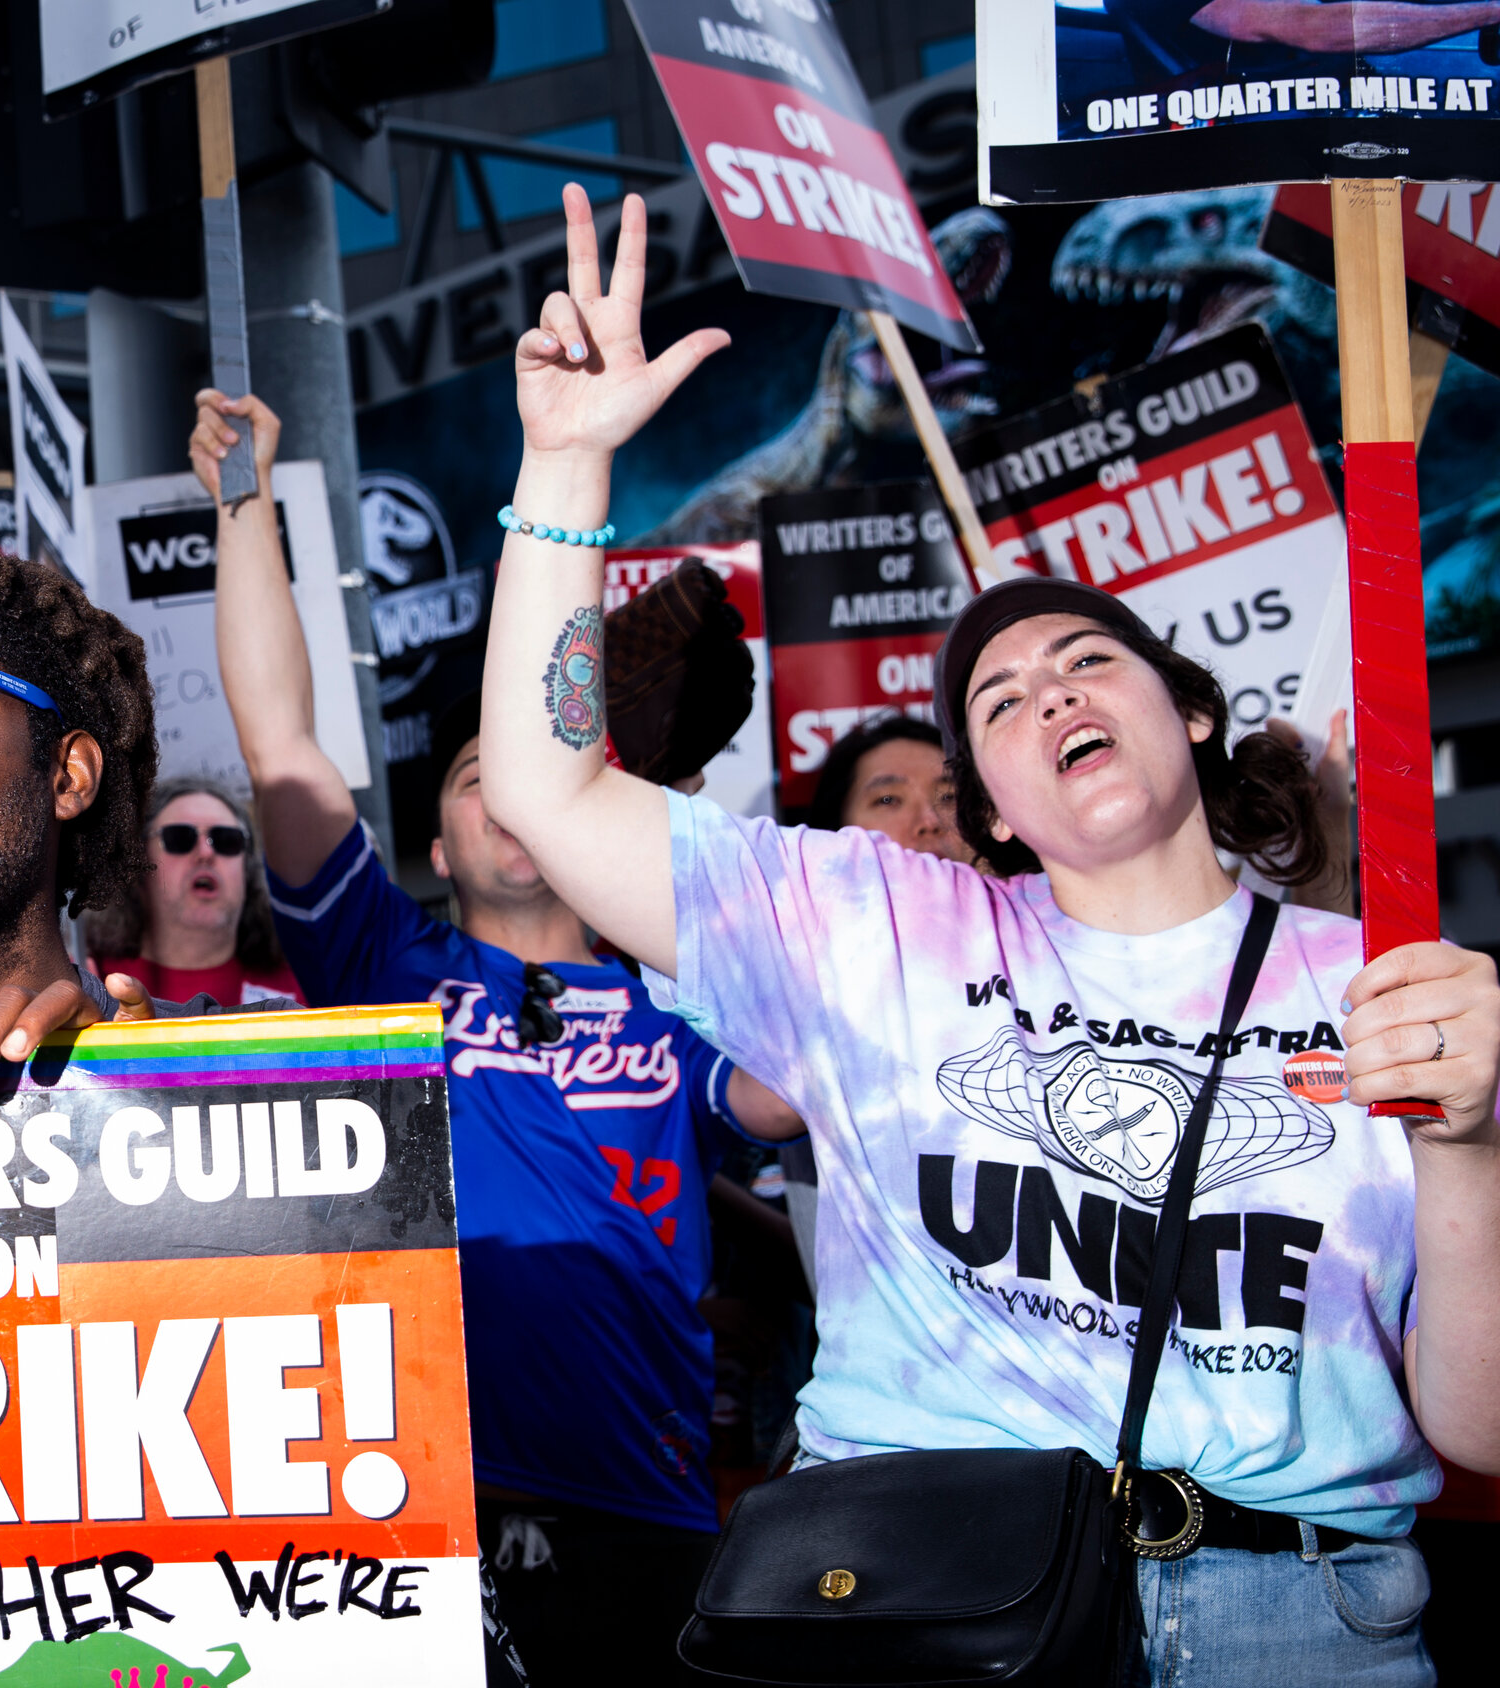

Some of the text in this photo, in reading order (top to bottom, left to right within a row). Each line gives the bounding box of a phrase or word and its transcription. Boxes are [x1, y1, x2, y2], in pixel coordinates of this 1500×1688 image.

[697, 17, 826, 94] AMERICA
[772, 102, 836, 159] ON
[1086, 76, 1493, 133] ONE QUARTER MILE AT
[704, 141, 934, 279] STRIKE!
[963, 359, 1260, 507] WRITERS GUILD
[1098, 455, 1141, 491] ON
[776, 511, 918, 557] WRITERS
[990, 430, 1305, 587] STRIKE!
[878, 553, 915, 583] OF
[371, 586, 482, 660] WORLD
[829, 584, 970, 630] AMERICA
[1202, 588, 1292, 647] US
[877, 653, 934, 695] ON
[1087, 1017, 1344, 1061] SAG-AFTRA
[1284, 1060, 1346, 1073] WRITERS GUIL
[1128, 1067, 1154, 1082] NO
[1283, 1072, 1305, 1088] ON
[98, 1098, 388, 1208] GUILD
[916, 1152, 1326, 1332] UNITE
[214, 1541, 430, 1623] WE'RE
